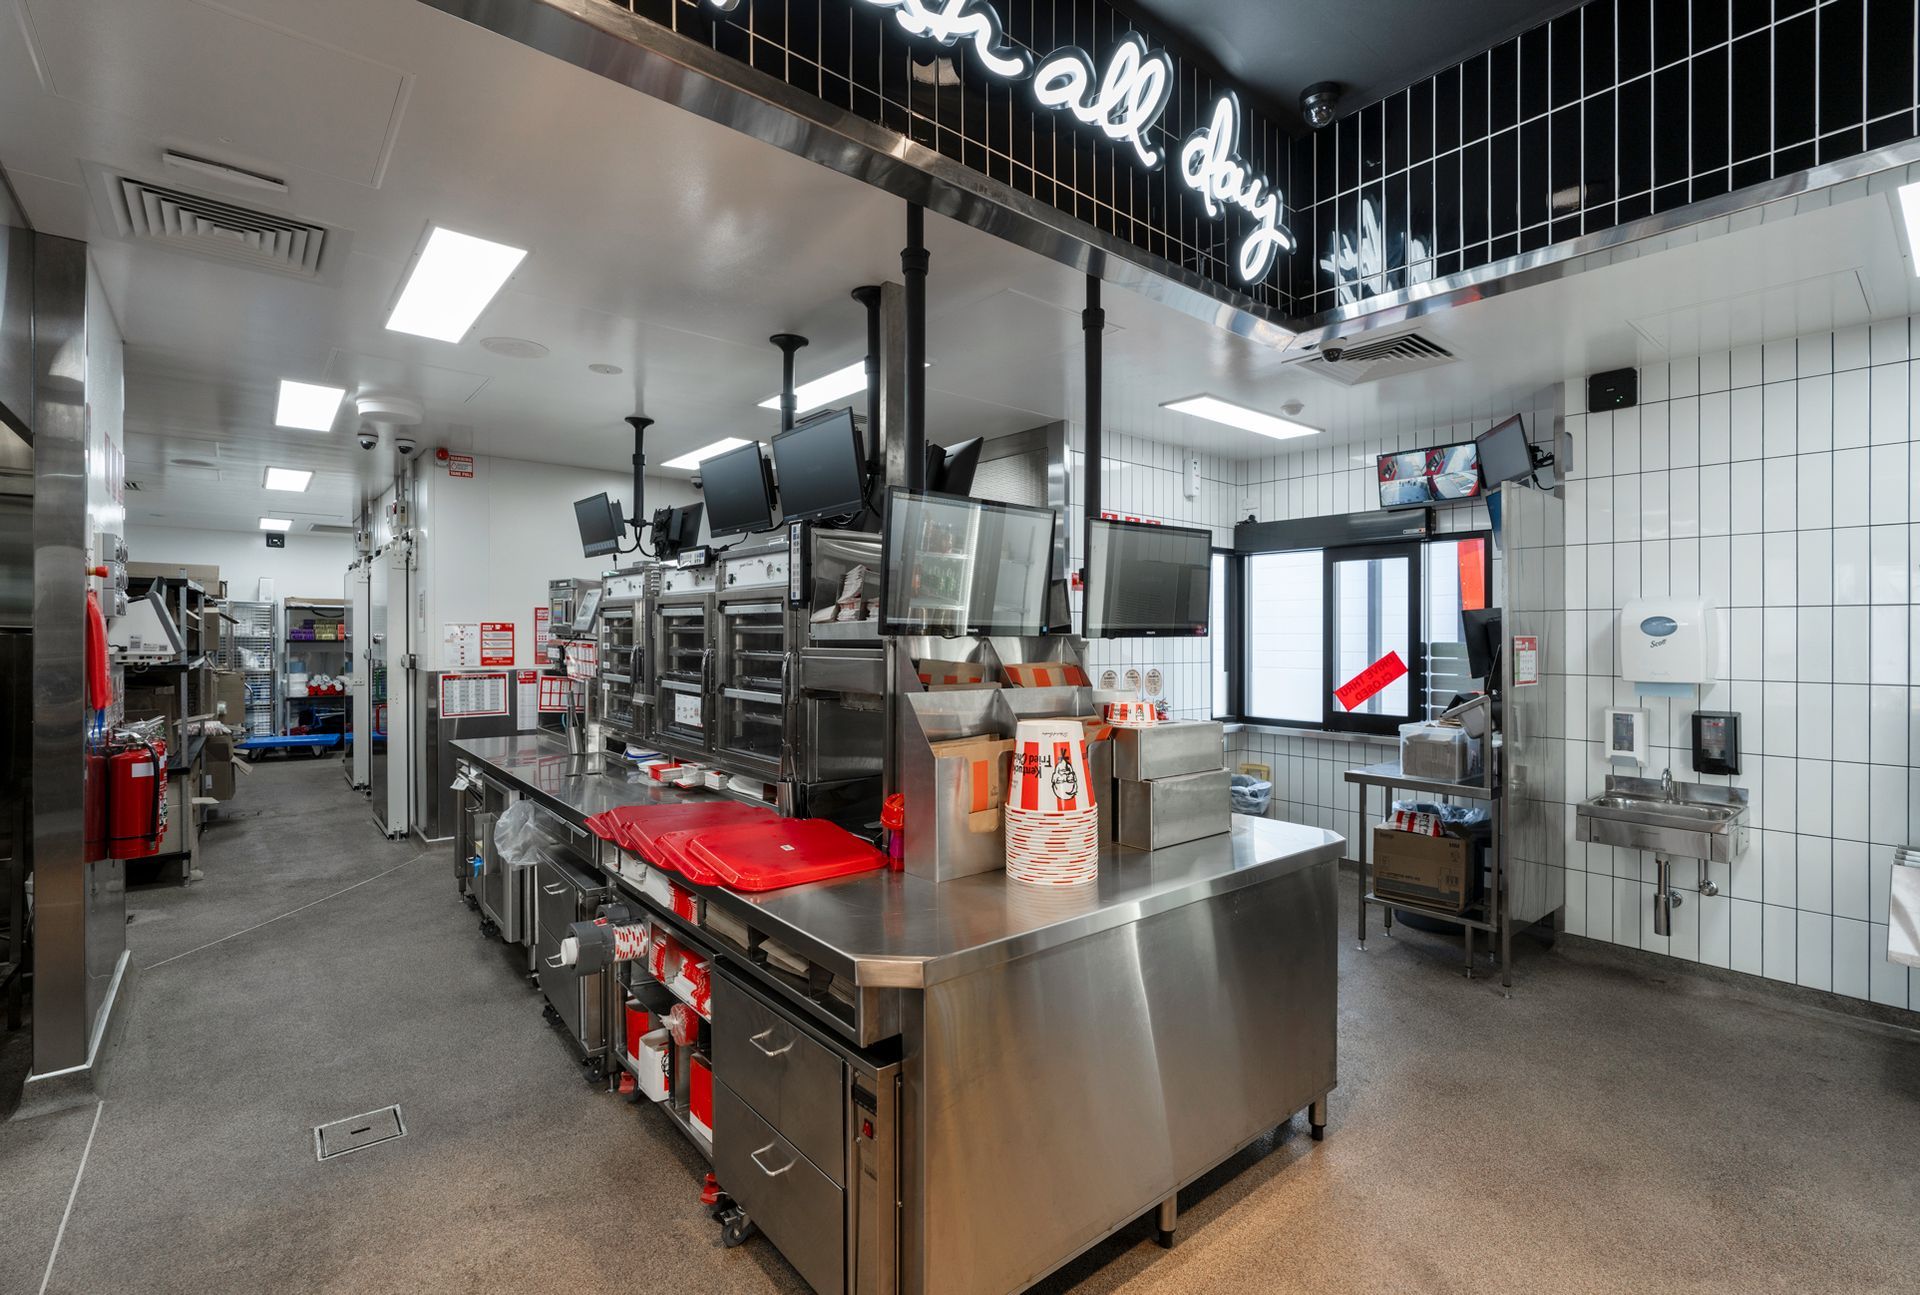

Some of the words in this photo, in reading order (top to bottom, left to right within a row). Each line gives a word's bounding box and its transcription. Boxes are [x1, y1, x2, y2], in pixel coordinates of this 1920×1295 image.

[1034, 38, 1166, 168] all
[1181, 92, 1289, 282] day
[1650, 638, 1667, 648] Scott
[1029, 754, 1052, 768] Fried
